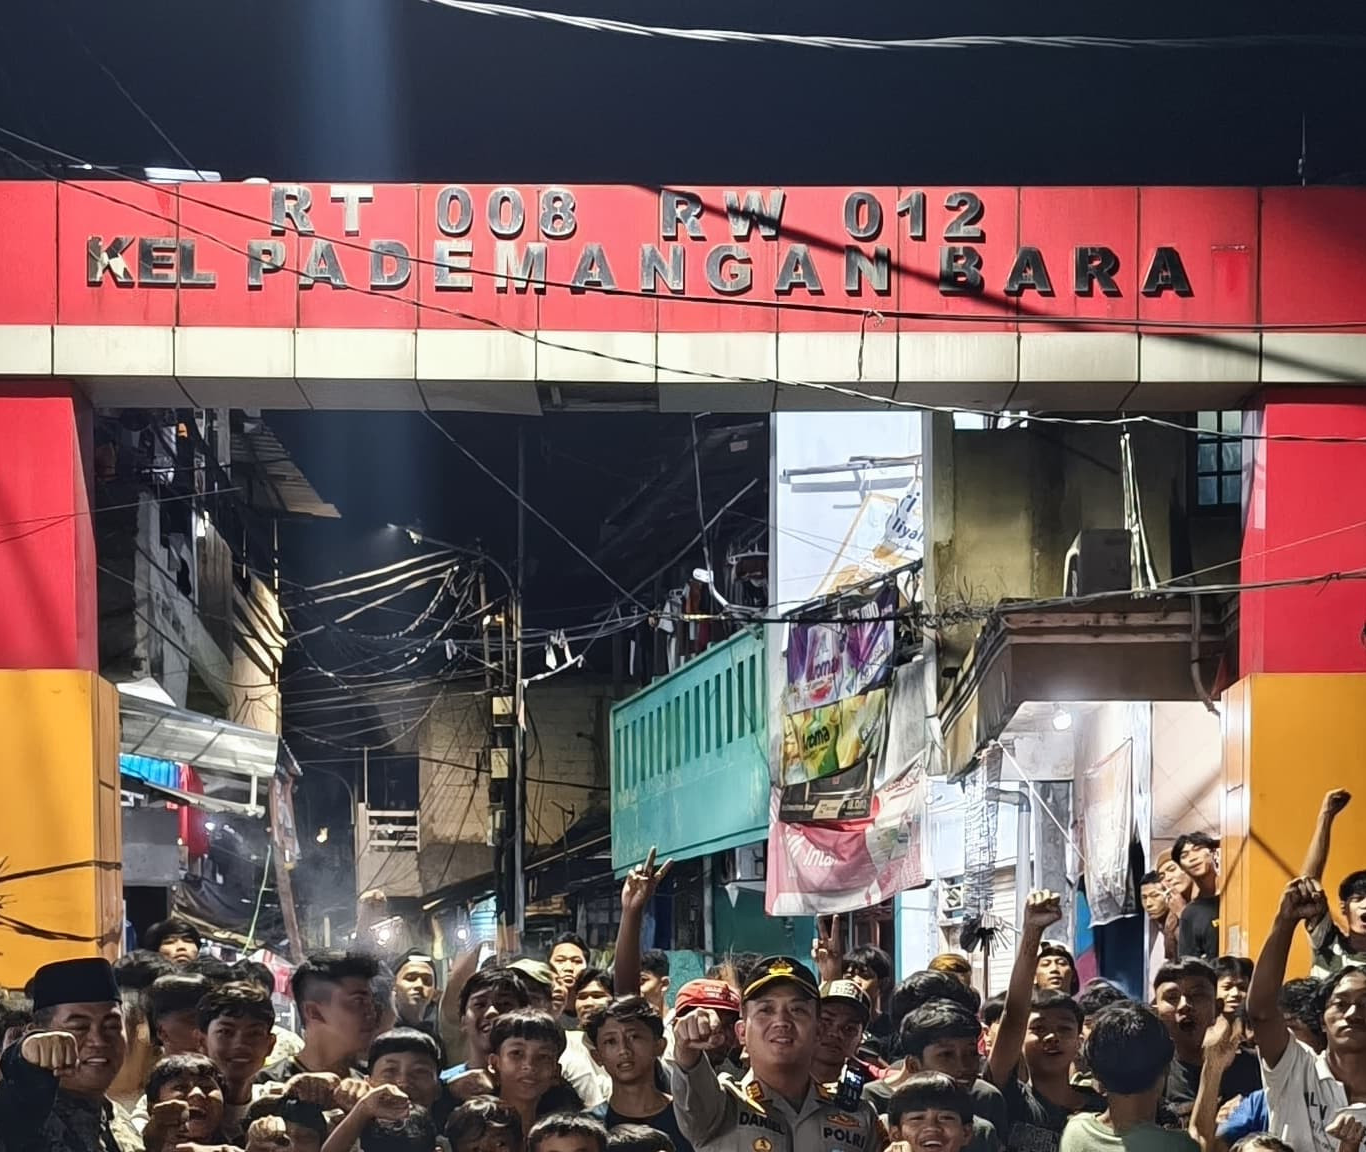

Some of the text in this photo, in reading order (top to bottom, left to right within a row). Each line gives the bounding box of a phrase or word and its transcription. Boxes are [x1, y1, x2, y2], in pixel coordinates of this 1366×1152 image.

[270, 184, 987, 243] RT 008 RW 012
[86, 234, 216, 287] KEL
[247, 238, 892, 295] PADEMANGAN
[823, 1127, 866, 1149] POLRI
